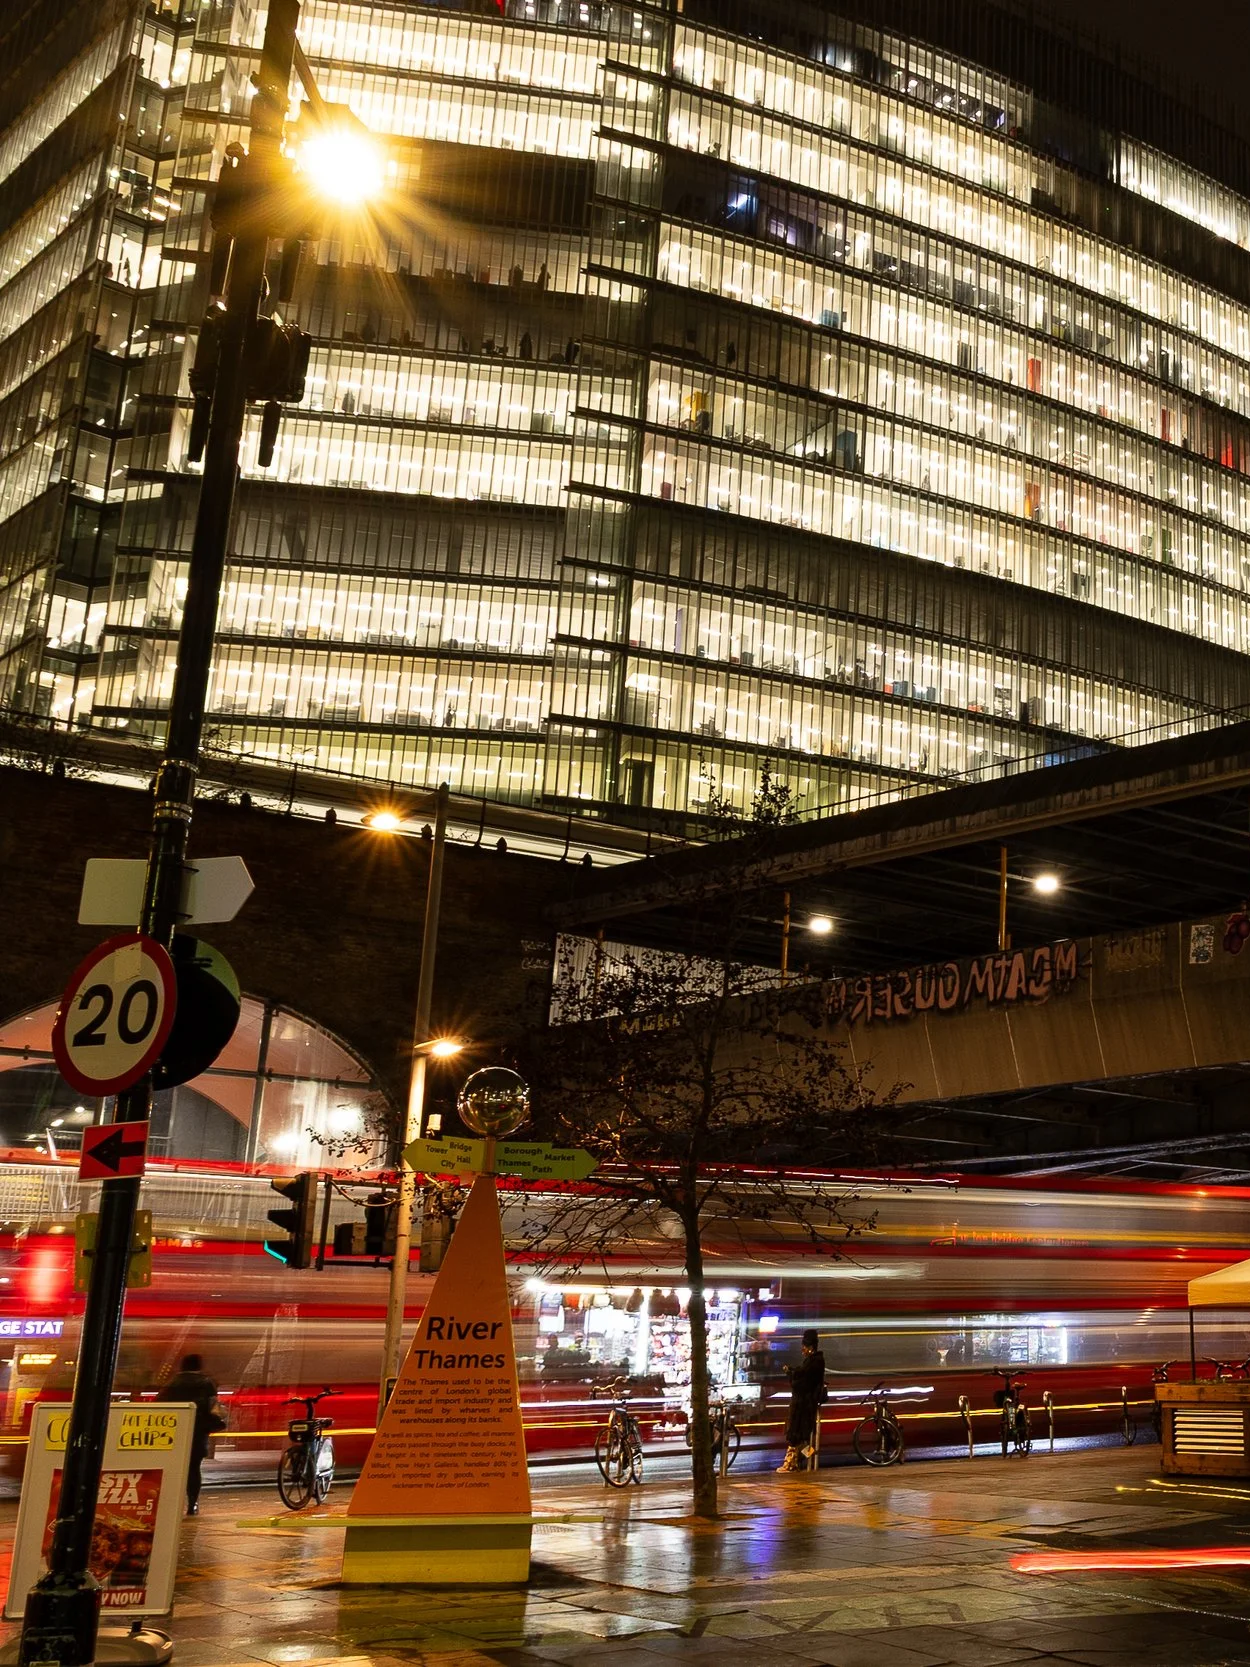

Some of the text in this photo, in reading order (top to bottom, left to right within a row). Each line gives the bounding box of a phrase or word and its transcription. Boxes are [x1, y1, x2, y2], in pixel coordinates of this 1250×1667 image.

[72, 979, 158, 1047] 20
[425, 1141, 472, 1154] Tower Bridge
[504, 1147, 542, 1157] Borough
[441, 1155, 471, 1169] City Hall
[497, 1159, 552, 1173] Thames Path
[0, 1321, 64, 1335] GE STAT
[426, 1316, 503, 1341] River
[415, 1350, 505, 1369] Thames
[488, 1388, 511, 1396] global
[436, 1398, 460, 1406] import
[146, 1499, 154, 1511] 5
[110, 1592, 143, 1605] NOW
